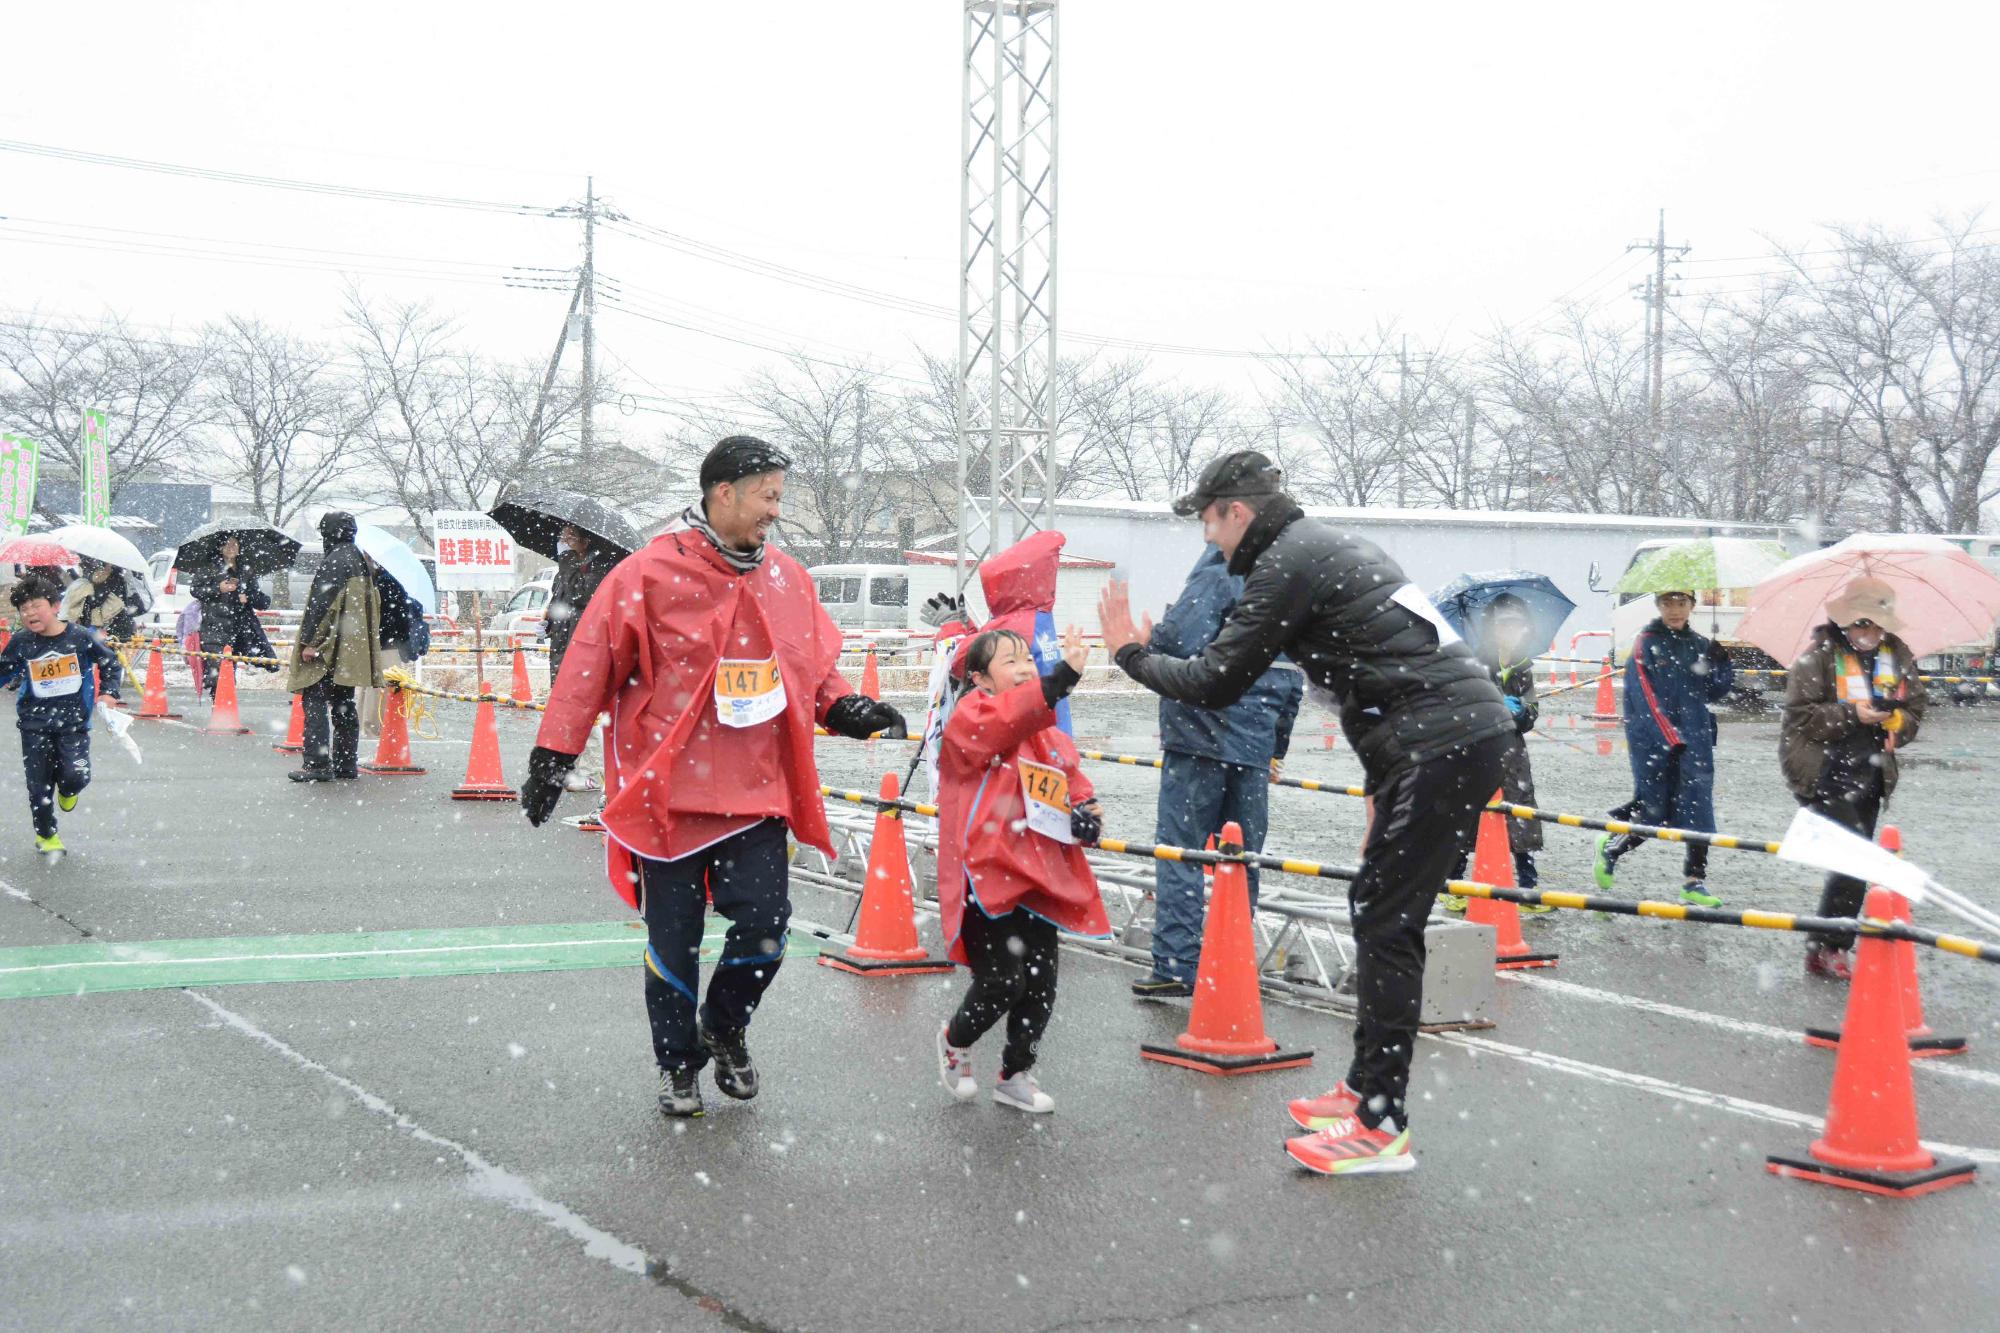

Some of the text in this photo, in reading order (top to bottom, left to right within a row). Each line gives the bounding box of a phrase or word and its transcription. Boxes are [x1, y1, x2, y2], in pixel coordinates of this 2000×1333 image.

[439, 538, 511, 566] 駐車禁止
[40, 662, 61, 678] 281
[724, 670, 758, 693] 147
[1028, 772, 1060, 800] 147
